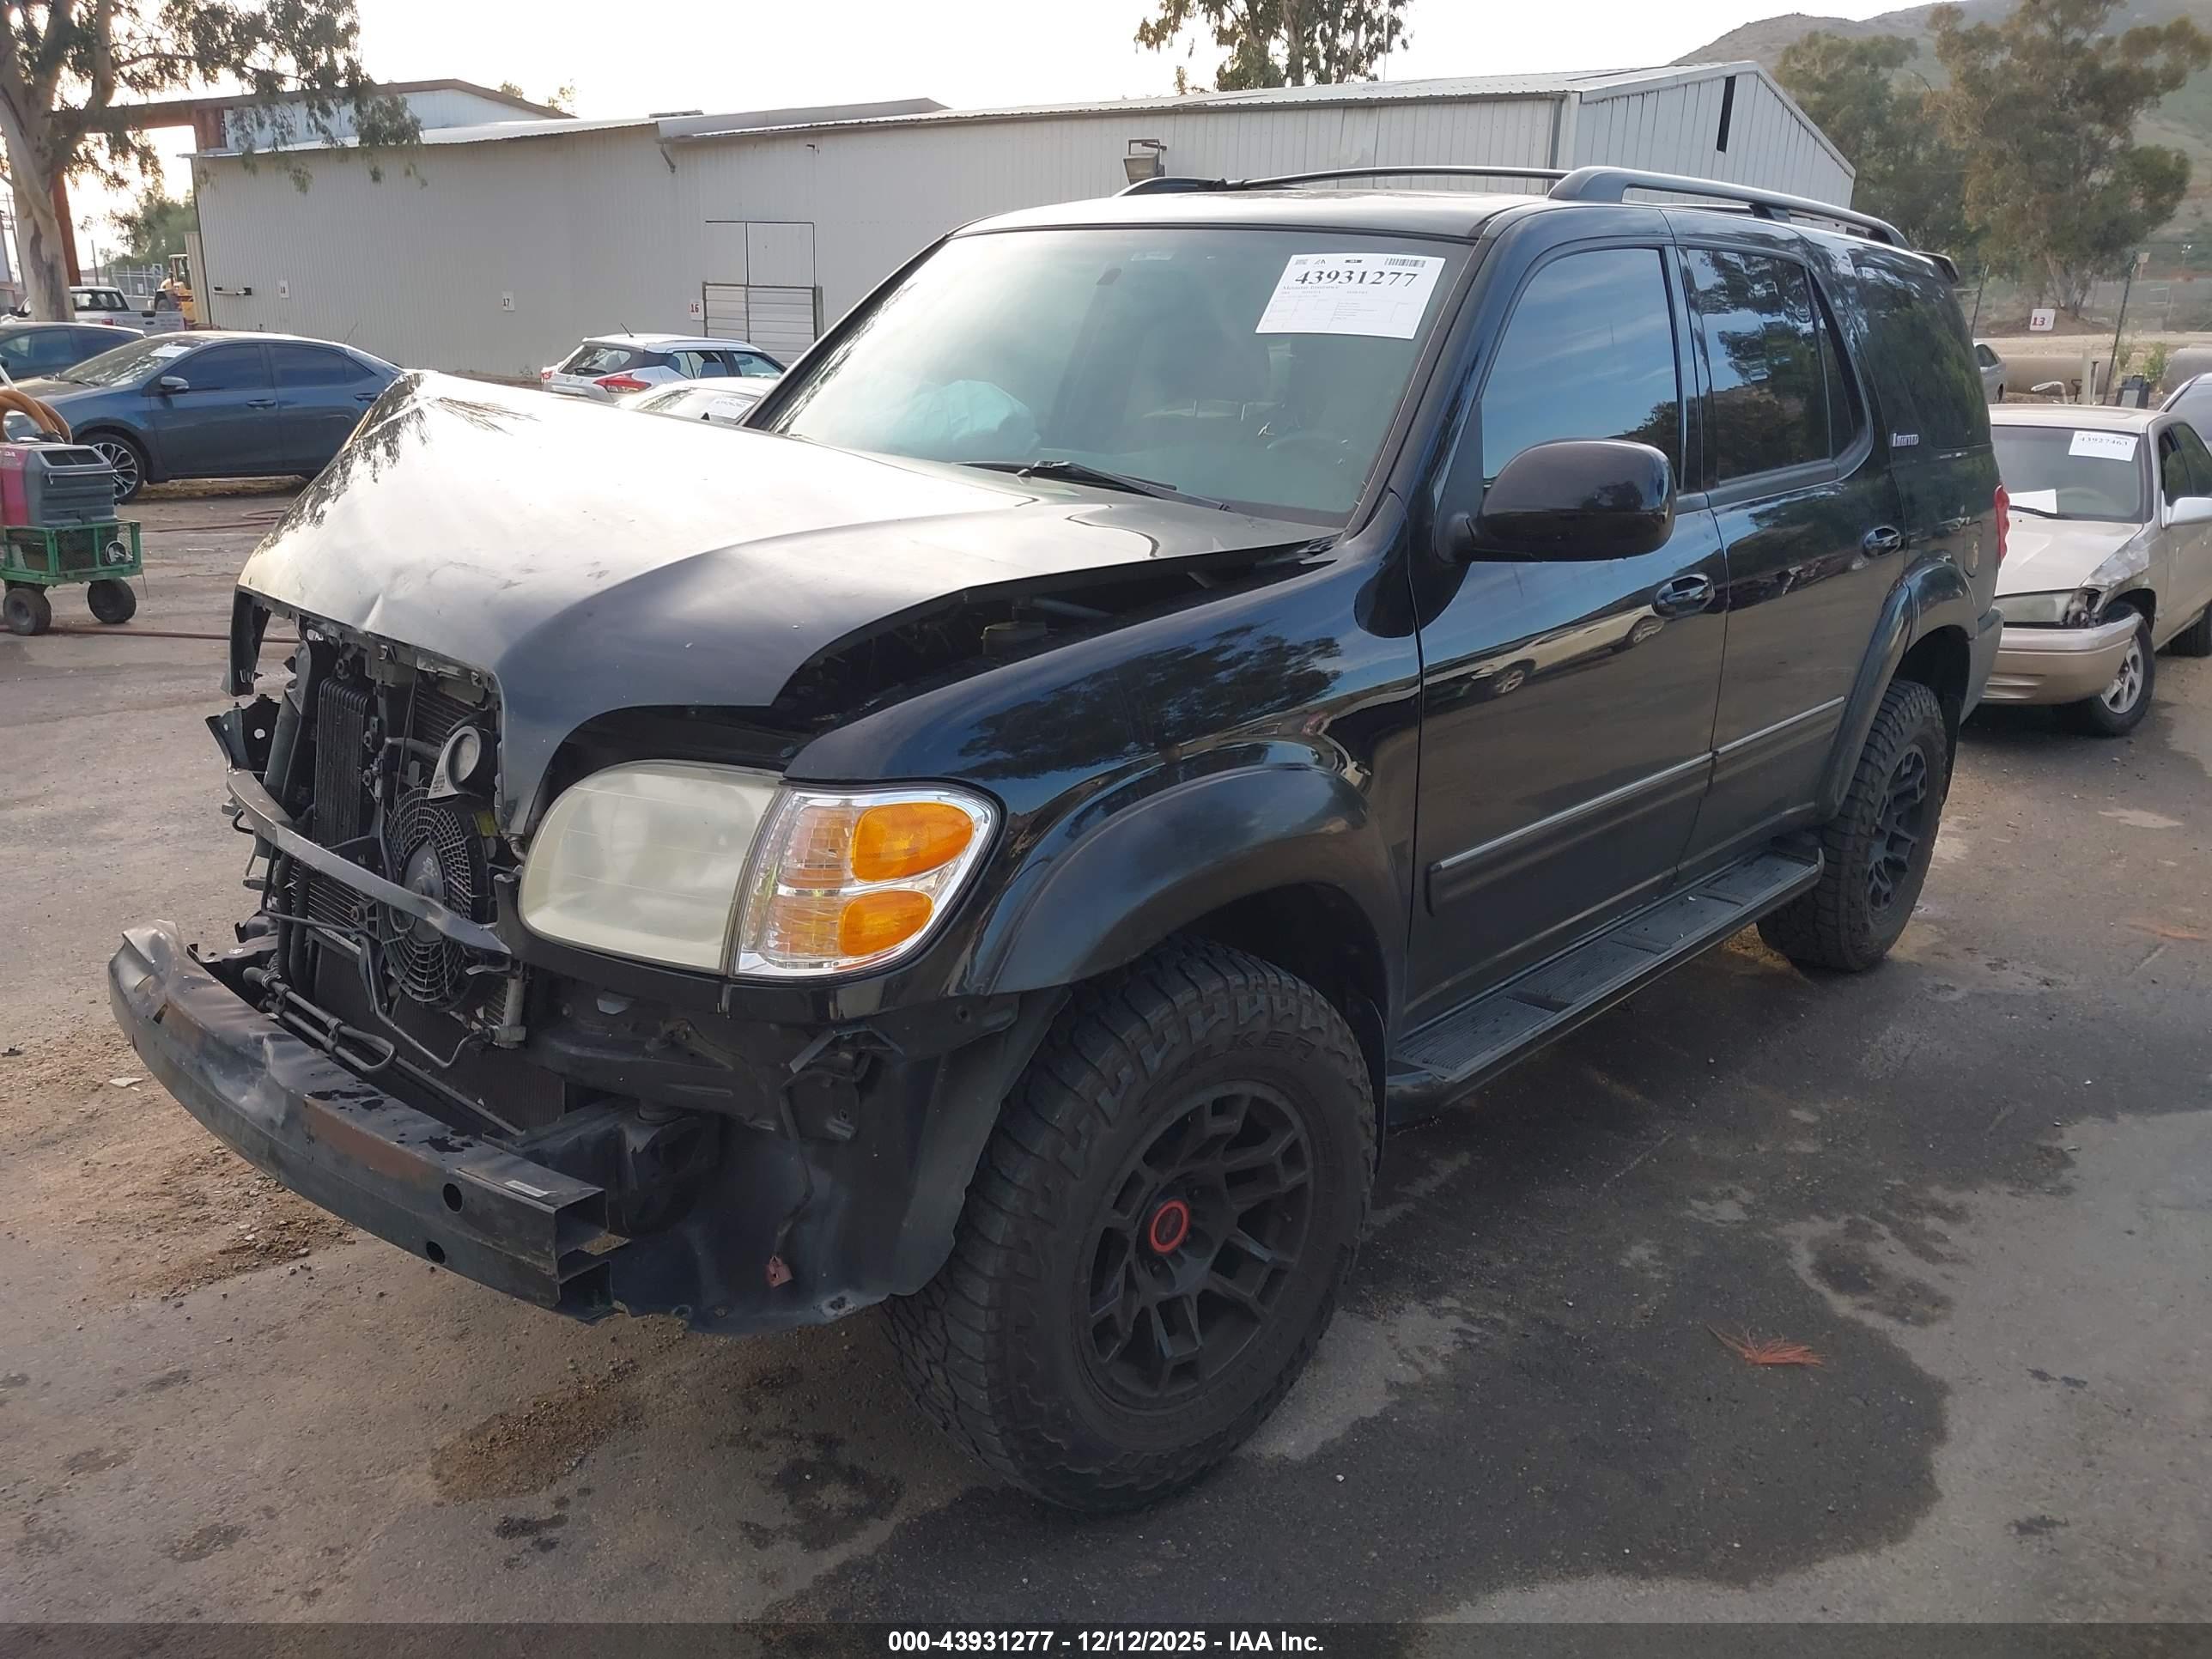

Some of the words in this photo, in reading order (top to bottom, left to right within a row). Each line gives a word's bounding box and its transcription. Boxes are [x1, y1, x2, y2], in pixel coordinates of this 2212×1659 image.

[1295, 270, 1419, 287] 43931277
[503, 298, 510, 307] 17
[690, 303, 700, 313] 16
[2032, 316, 2046, 326] 13
